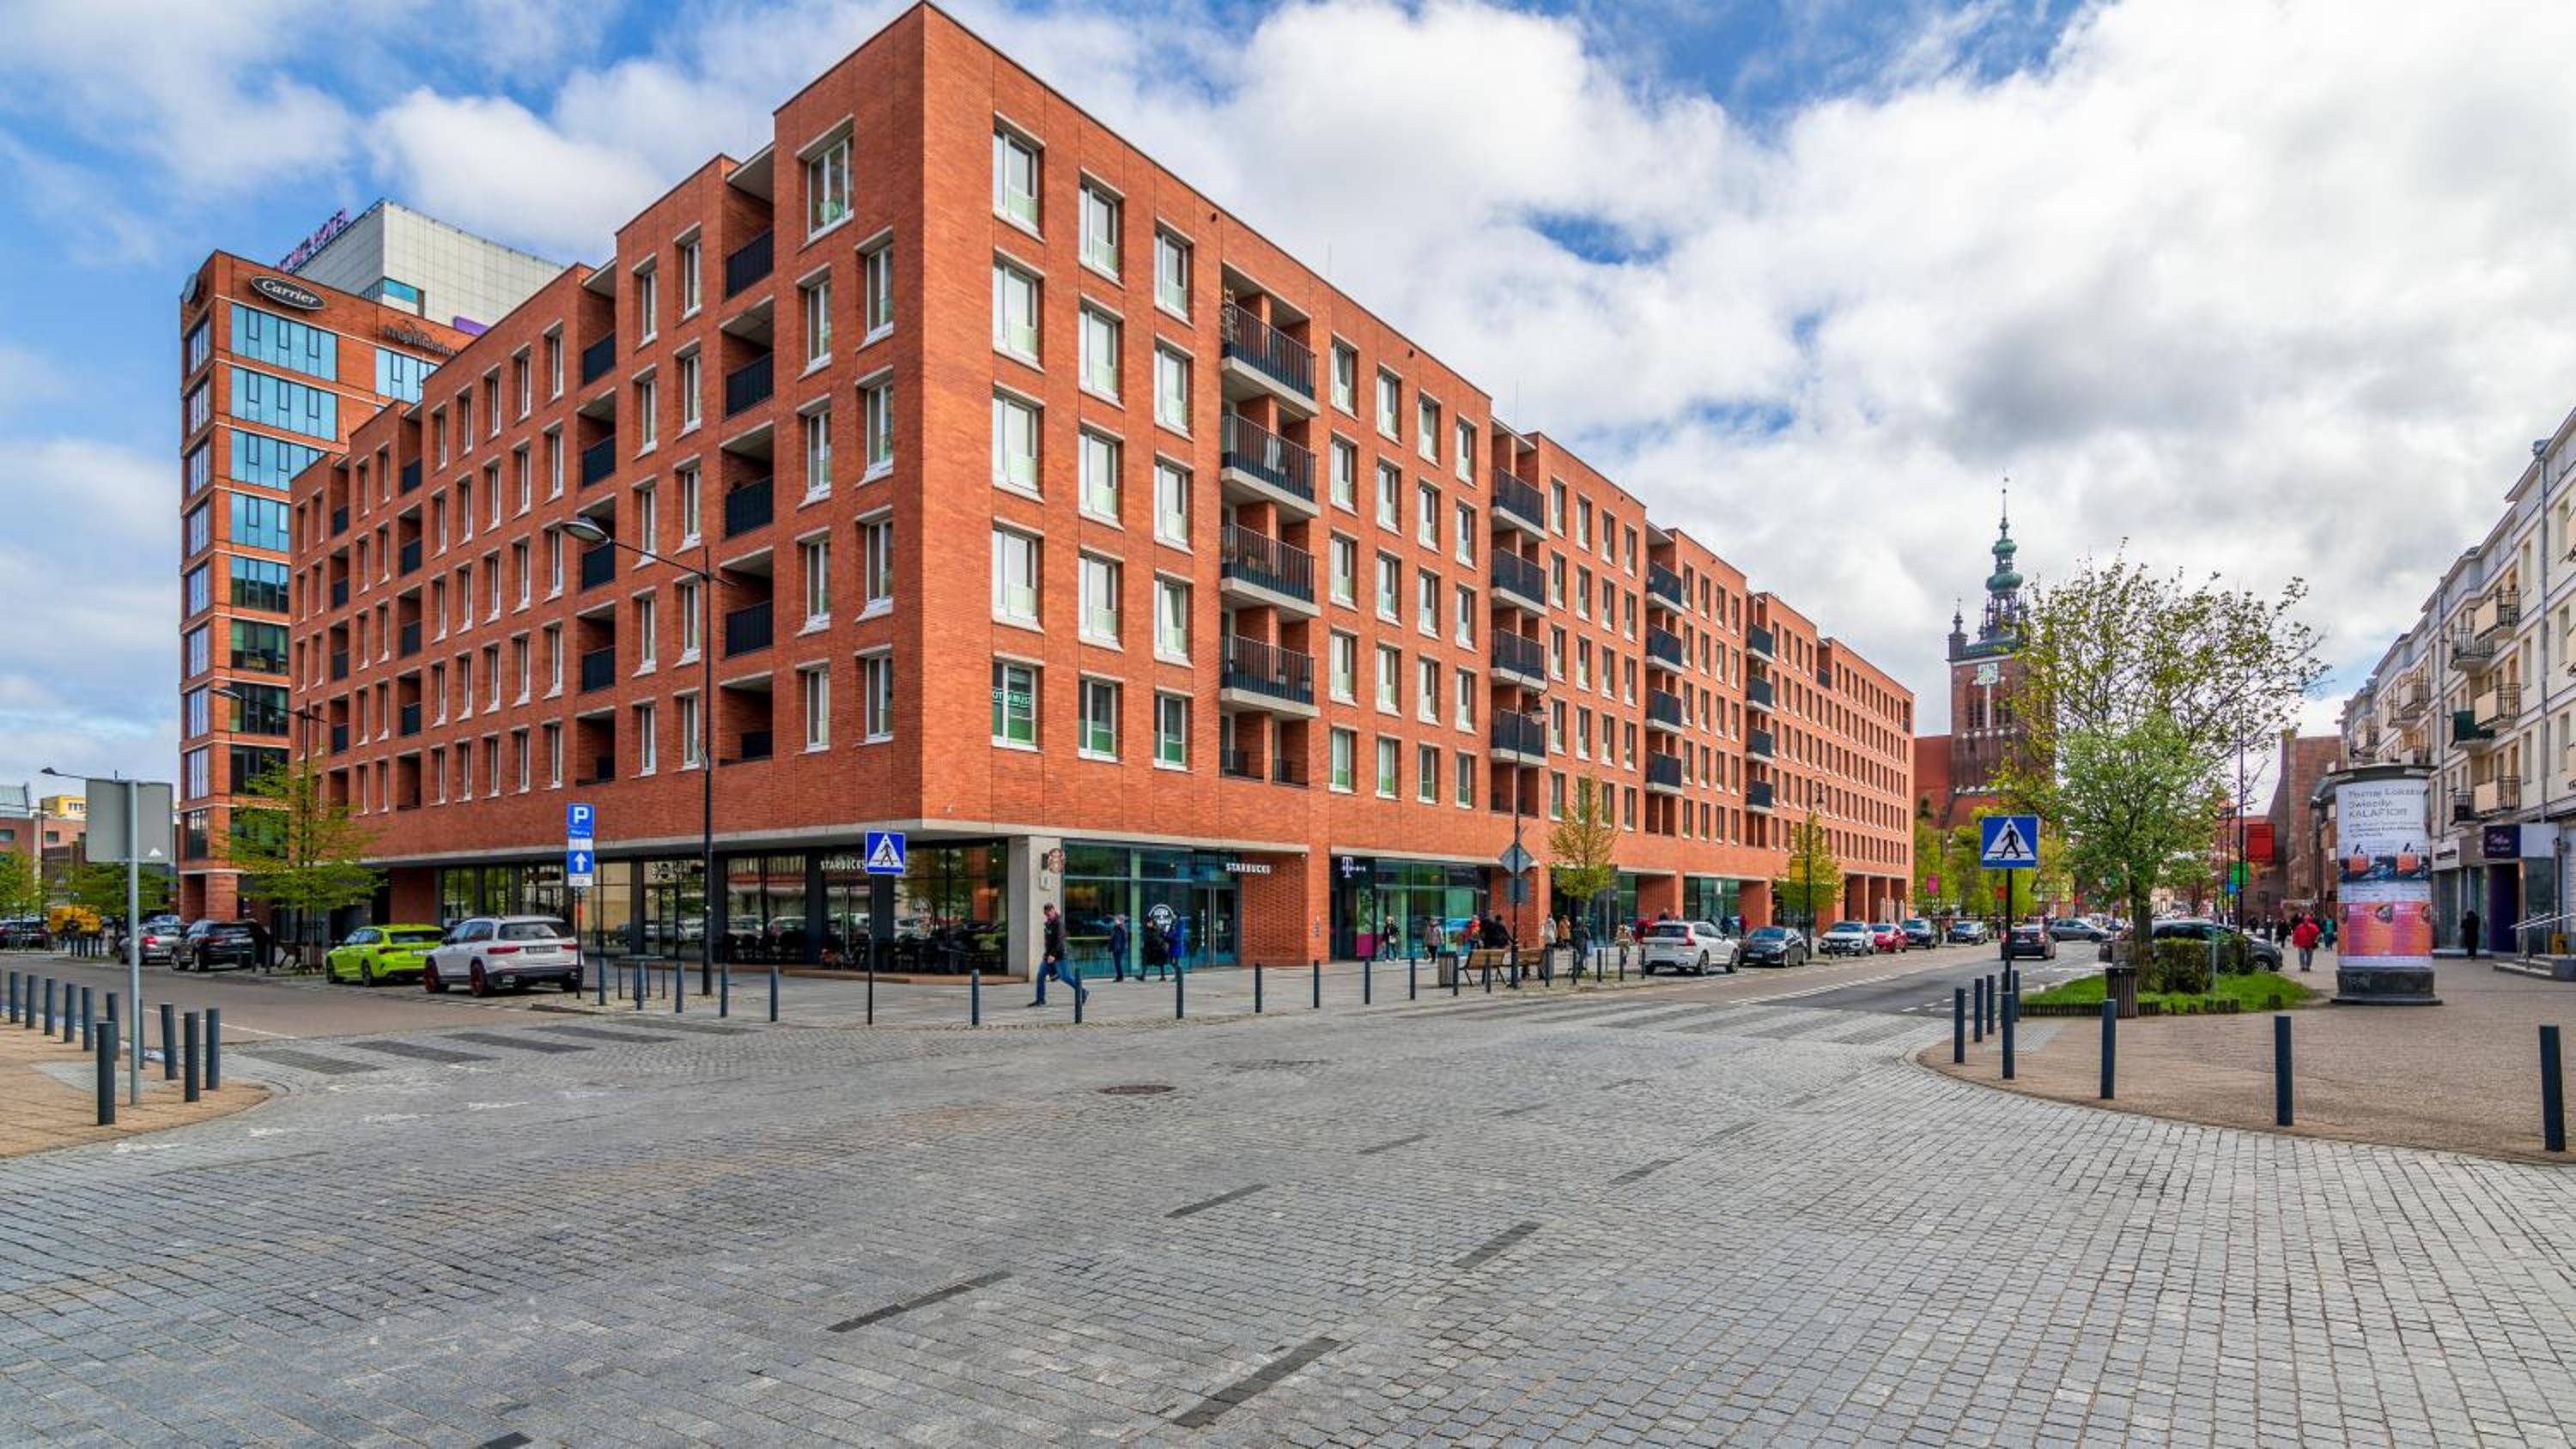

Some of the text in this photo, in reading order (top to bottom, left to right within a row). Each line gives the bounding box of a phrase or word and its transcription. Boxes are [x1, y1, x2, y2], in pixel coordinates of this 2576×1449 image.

[312, 207, 349, 248] HOTEL
[262, 281, 318, 303] Carrier
[574, 807, 588, 824] P
[1225, 862, 1272, 875] STARBUCKS
